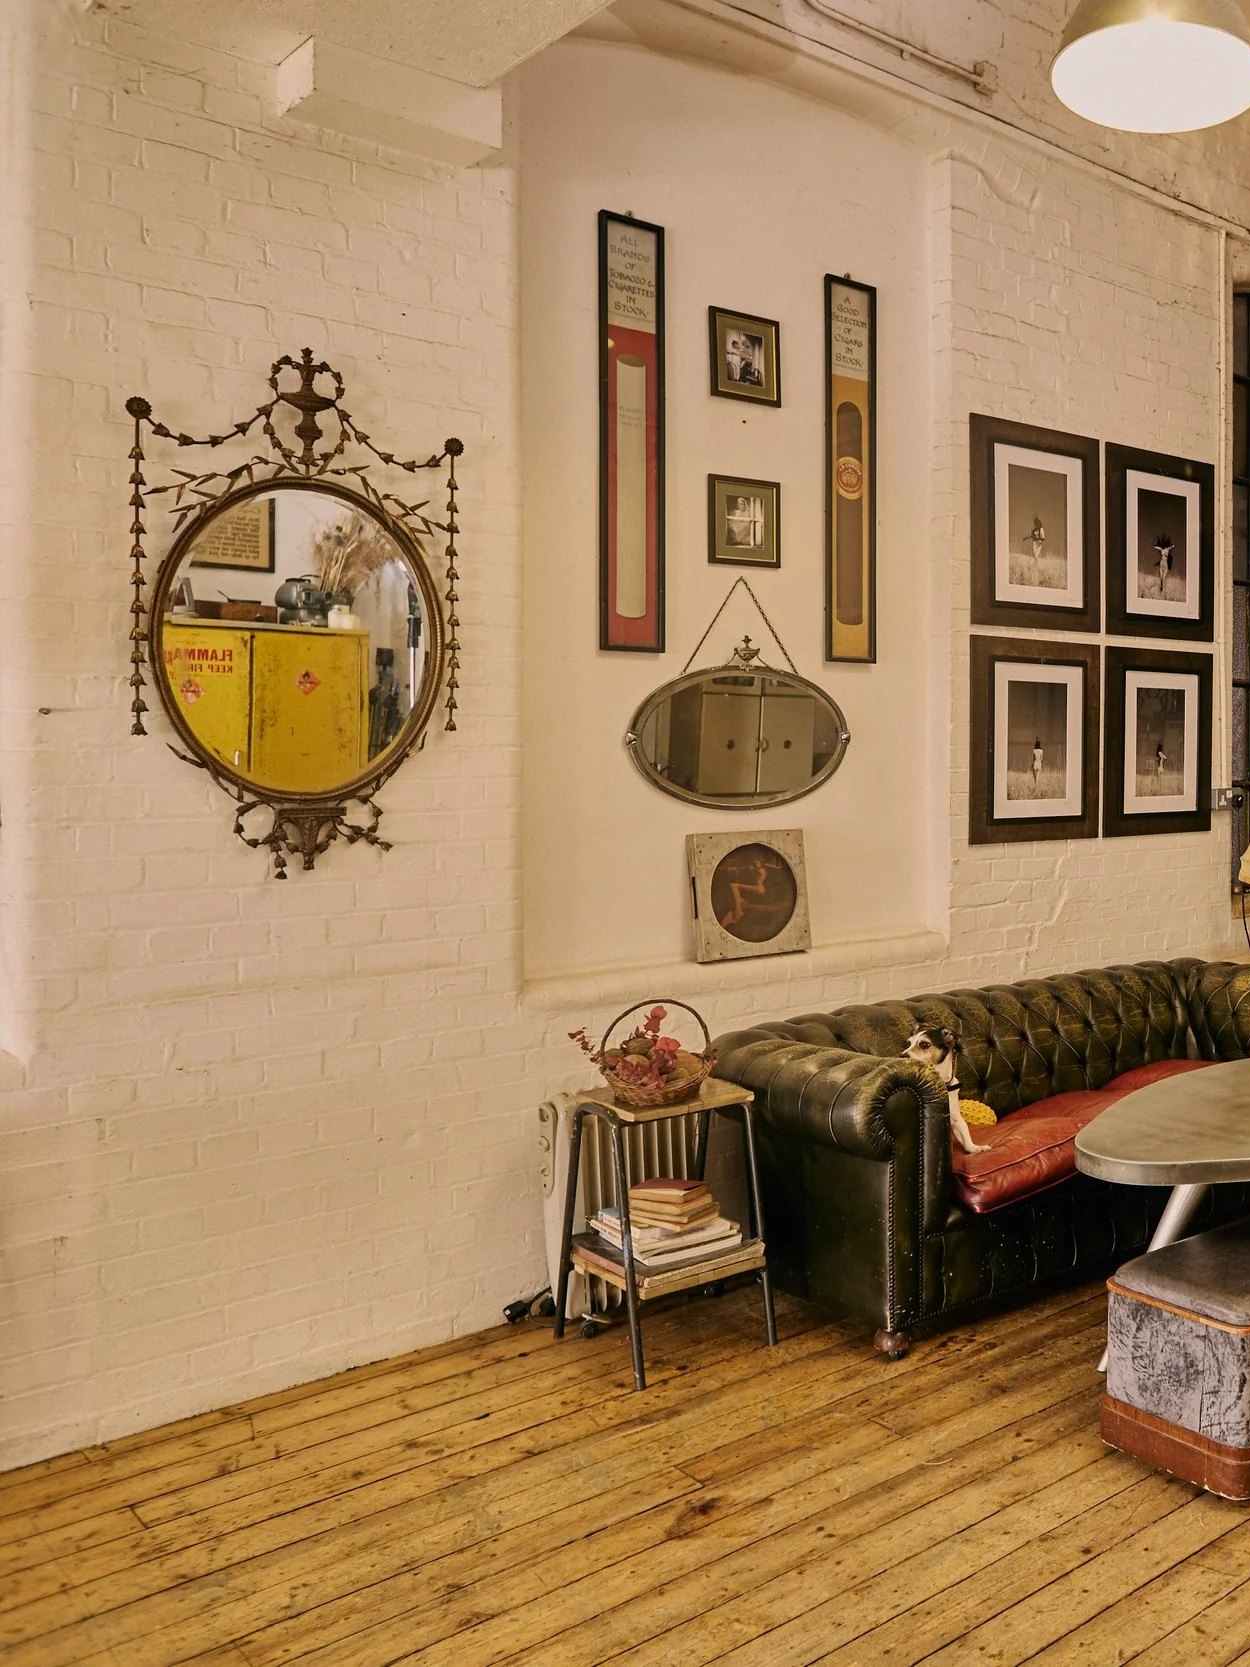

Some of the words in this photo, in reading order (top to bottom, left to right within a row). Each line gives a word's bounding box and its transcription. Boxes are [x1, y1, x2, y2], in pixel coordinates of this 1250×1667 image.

[620, 235, 638, 247] ALL
[610, 244, 650, 262] BRANDS
[624, 262, 636, 270] OF
[608, 268, 646, 285] TOBACCO
[608, 280, 655, 299] CIGARETTES
[626, 295, 636, 304] IN
[837, 304, 859, 316] GOOD
[831, 312, 867, 329] SELECTION
[834, 333, 863, 347] CIGARS
[845, 347, 853, 355] IN
